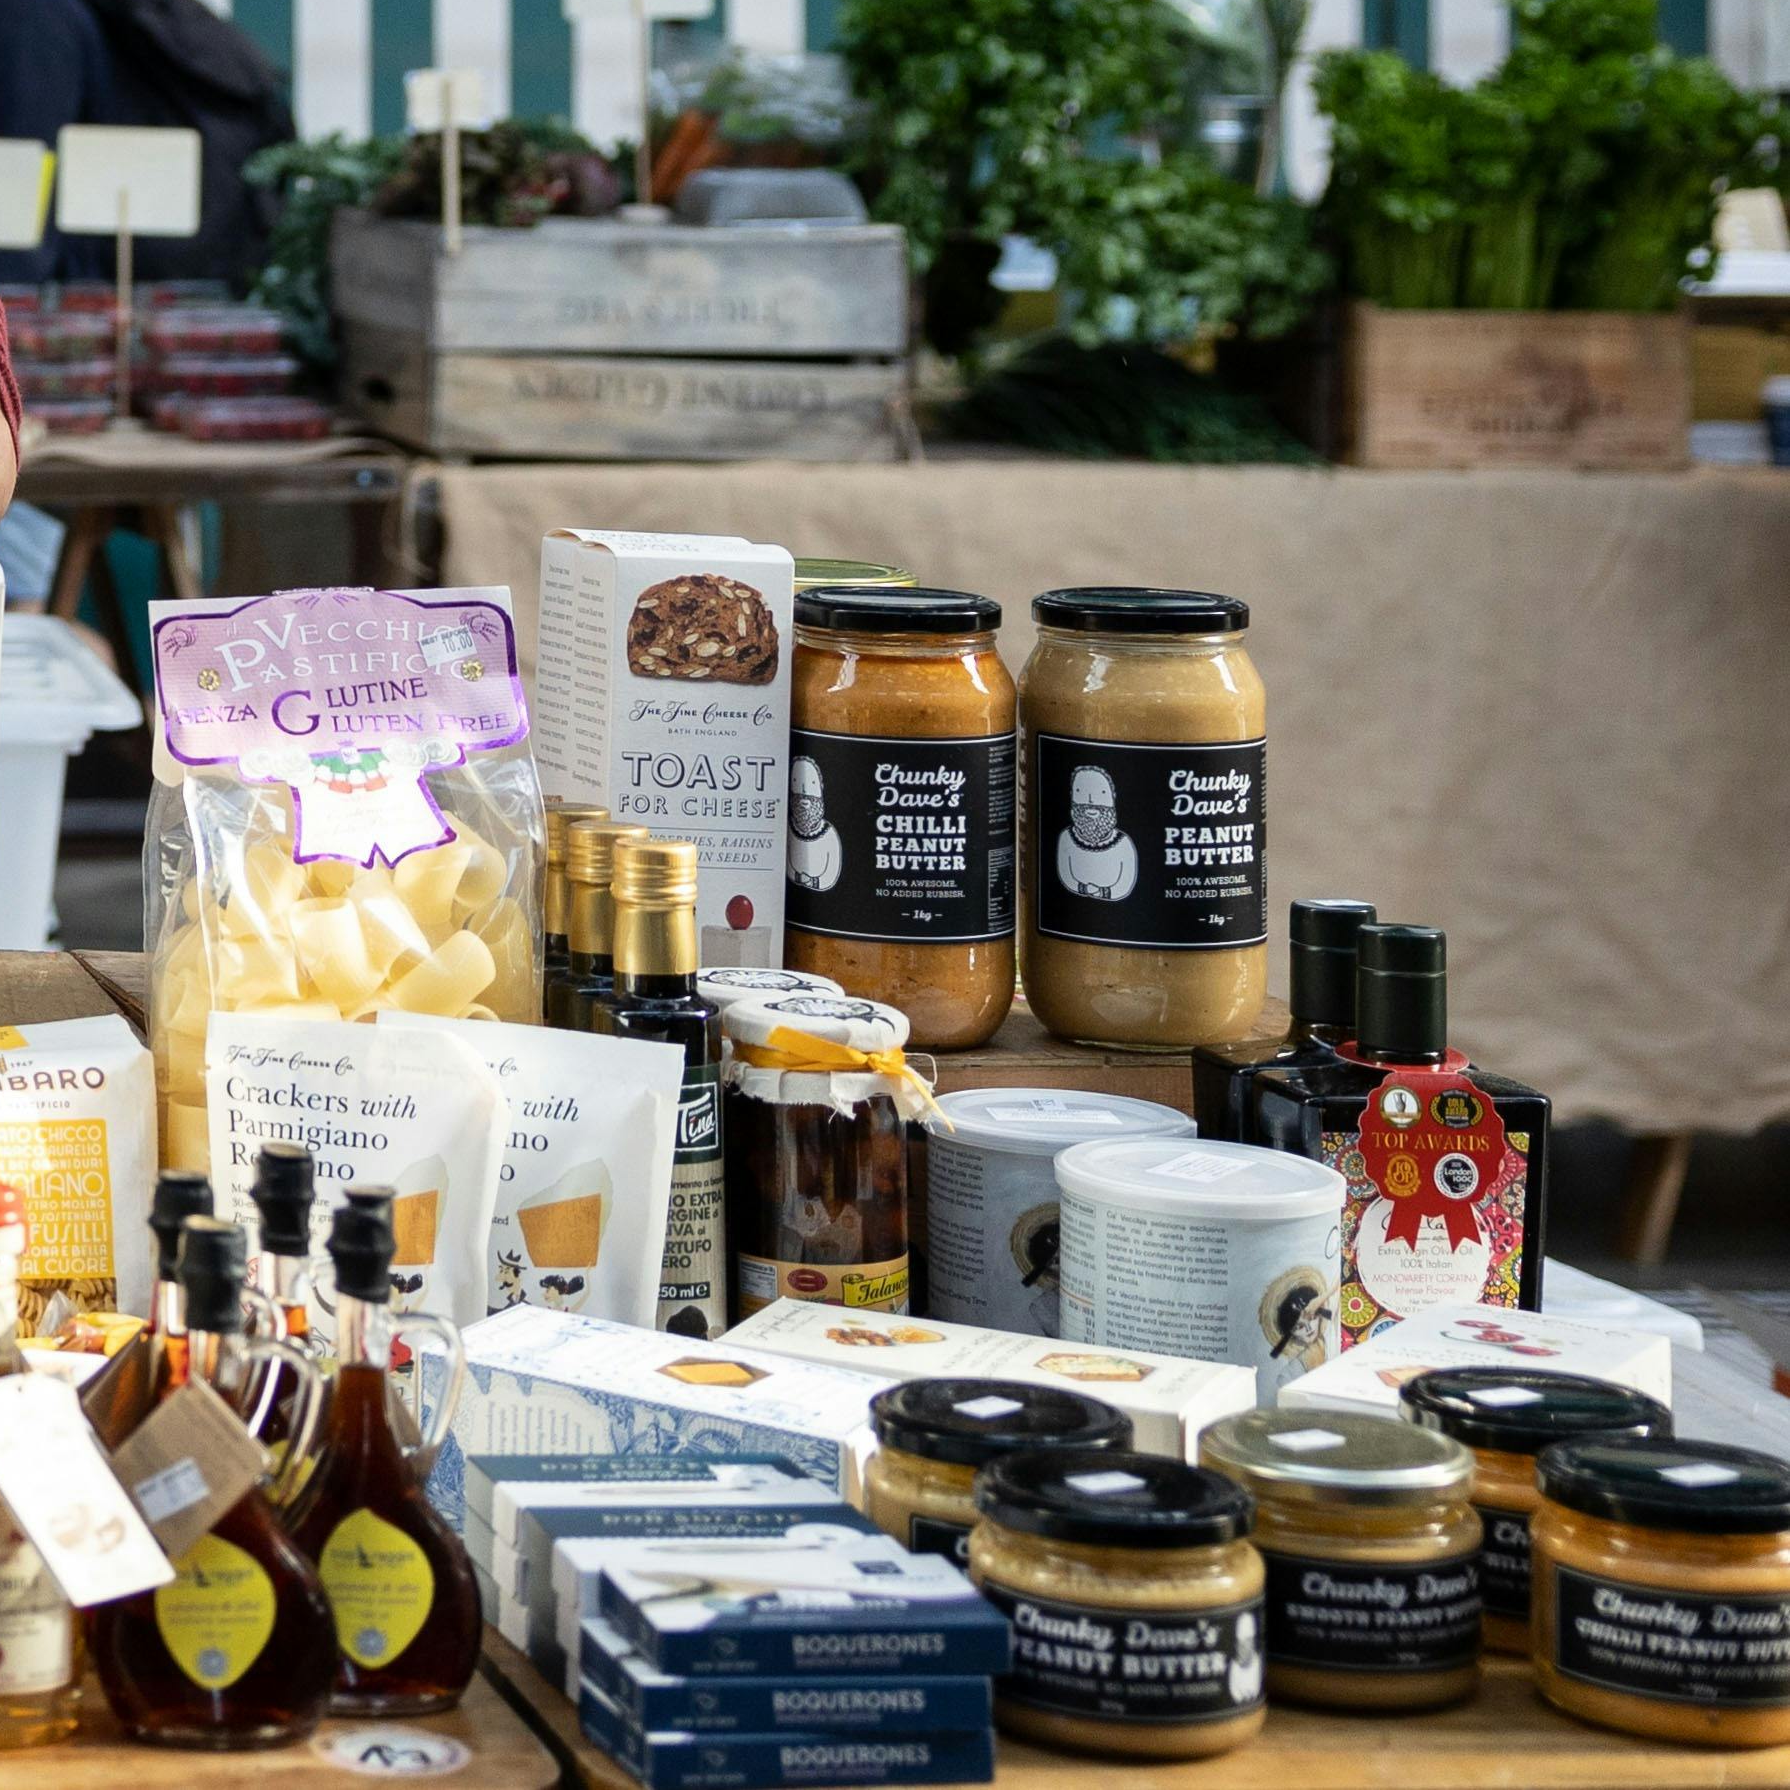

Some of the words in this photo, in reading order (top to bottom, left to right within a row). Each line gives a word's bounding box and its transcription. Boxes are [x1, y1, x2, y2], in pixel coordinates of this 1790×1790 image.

[421, 635, 439, 646] BEST
[441, 628, 469, 641] BEFORE
[441, 636, 473, 653] 10.00
[177, 704, 258, 725] SENZA
[703, 702, 748, 722] CHEESE
[438, 713, 510, 732] FREE
[622, 751, 775, 791] TOAST
[875, 763, 966, 791] Chunky
[1169, 769, 1252, 797] Chunky
[620, 793, 669, 814] FOR
[681, 796, 776, 819] CHEESE
[877, 786, 960, 807] Dave's
[1171, 794, 1248, 815] Dave's
[876, 815, 966, 834] CHILLI
[1165, 824, 1254, 844] PEANUT
[721, 837, 773, 849] RAISINS
[876, 836, 966, 853] PEANUT
[717, 853, 757, 863] SEEDS
[876, 854, 966, 871] BUTTER
[1165, 845, 1254, 866] BUTTER
[886, 879, 908, 887] 100%
[911, 880, 957, 888] AWESOME.
[1176, 877, 1201, 886] 100%
[892, 890, 924, 898] ADDED
[1184, 889, 1218, 898] ADDED
[289, 1051, 330, 1071] CHEESE
[227, 1077, 349, 1113] Crackers
[360, 1094, 417, 1120] with
[524, 1096, 579, 1122] with
[35, 1125, 103, 1143] CHICCO
[229, 1109, 388, 1152] Parmigiano
[47, 1144, 102, 1156] AURELIO
[1372, 1133, 1409, 1149] TOP
[1415, 1133, 1490, 1152] AWARDS
[1445, 1168, 1472, 1176] London
[61, 1198, 106, 1210] MOLINO
[41, 1210, 106, 1222] SOSTENIBILE
[29, 1223, 108, 1243] FUSILLI
[1378, 1246, 1401, 1256] Extra
[23, 1259, 41, 1275] AL
[45, 1257, 108, 1274] CUORE
[1426, 1259, 1452, 1269] Italian
[1372, 1273, 1434, 1283] MONOVARIETY
[1436, 1273, 1478, 1283] CORATINA
[1302, 1570, 1407, 1607] Chunky
[1592, 1587, 1701, 1635] Chunky
[1015, 1604, 1115, 1652] Chunky
[1126, 1620, 1219, 1651] Dave's
[792, 1632, 946, 1656] BOQUERONES
[1122, 1653, 1227, 1678] BUTTER
[773, 1688, 926, 1713] BOQUERONES
[780, 1743, 931, 1766] BOQUERONES
